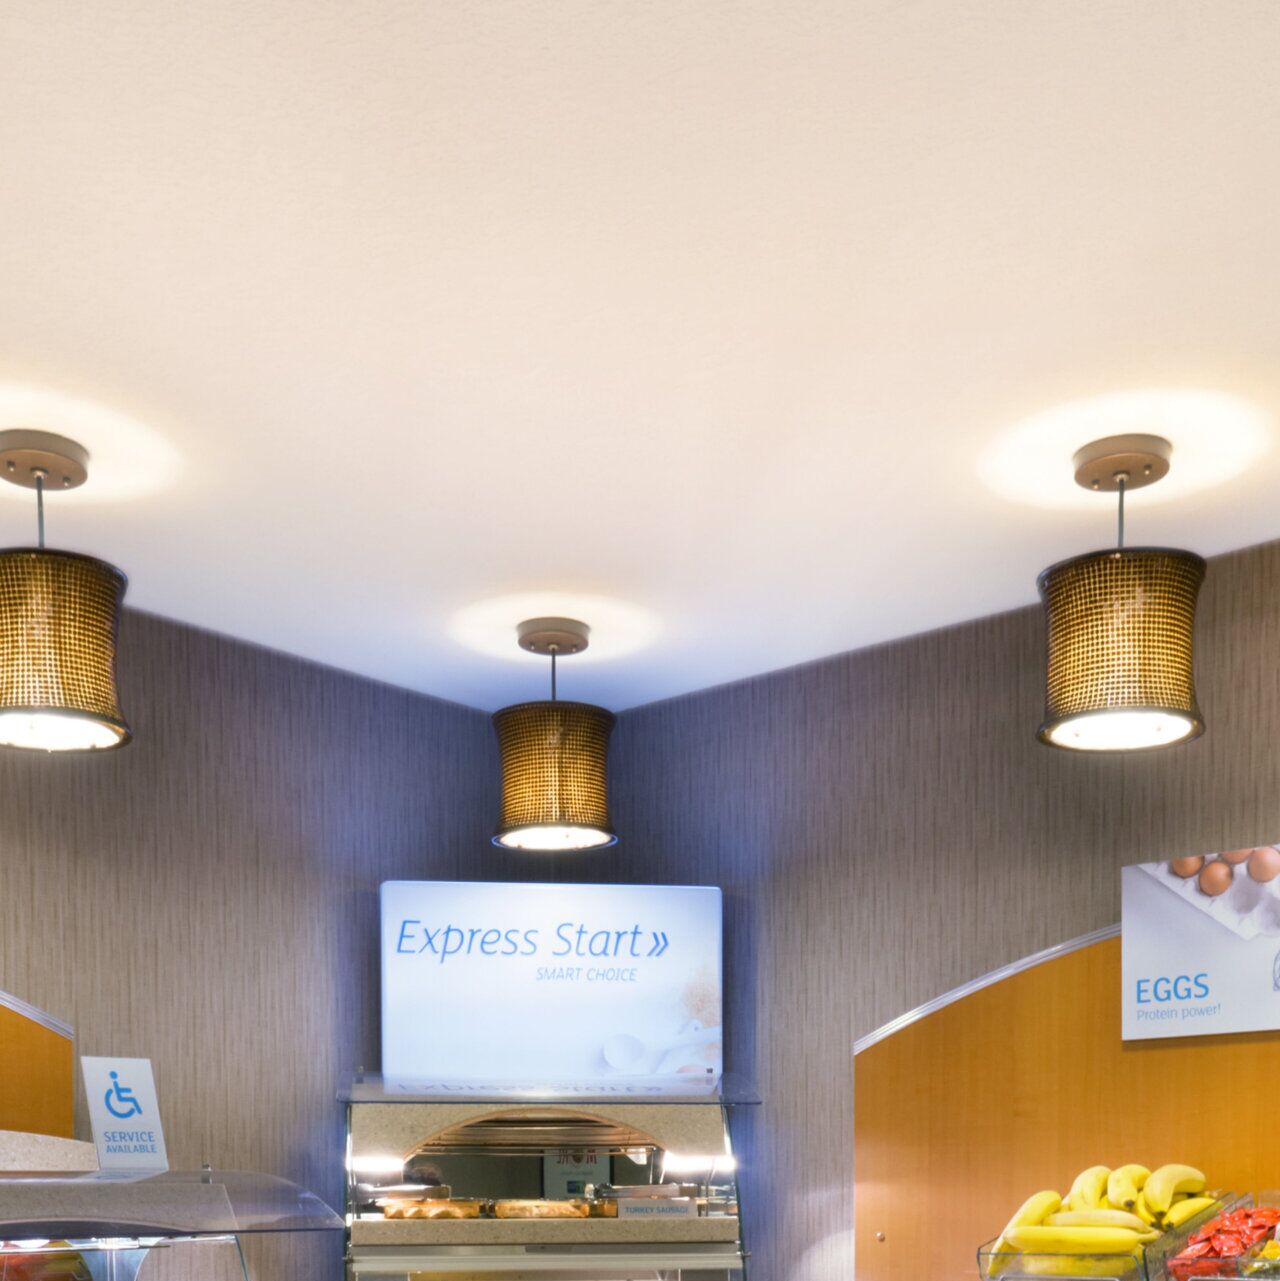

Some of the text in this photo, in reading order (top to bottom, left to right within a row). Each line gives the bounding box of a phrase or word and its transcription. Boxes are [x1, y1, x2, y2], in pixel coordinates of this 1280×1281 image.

[397, 919, 539, 963] Express
[536, 966, 638, 982] SMART CHOICE
[1136, 973, 1209, 1004] EGGS
[1136, 1003, 1221, 1021] Protein power!
[103, 1131, 155, 1142] SERVICE
[106, 1144, 157, 1153] AVAILABLE
[625, 1206, 688, 1214] TURKEY SAUSAGE
